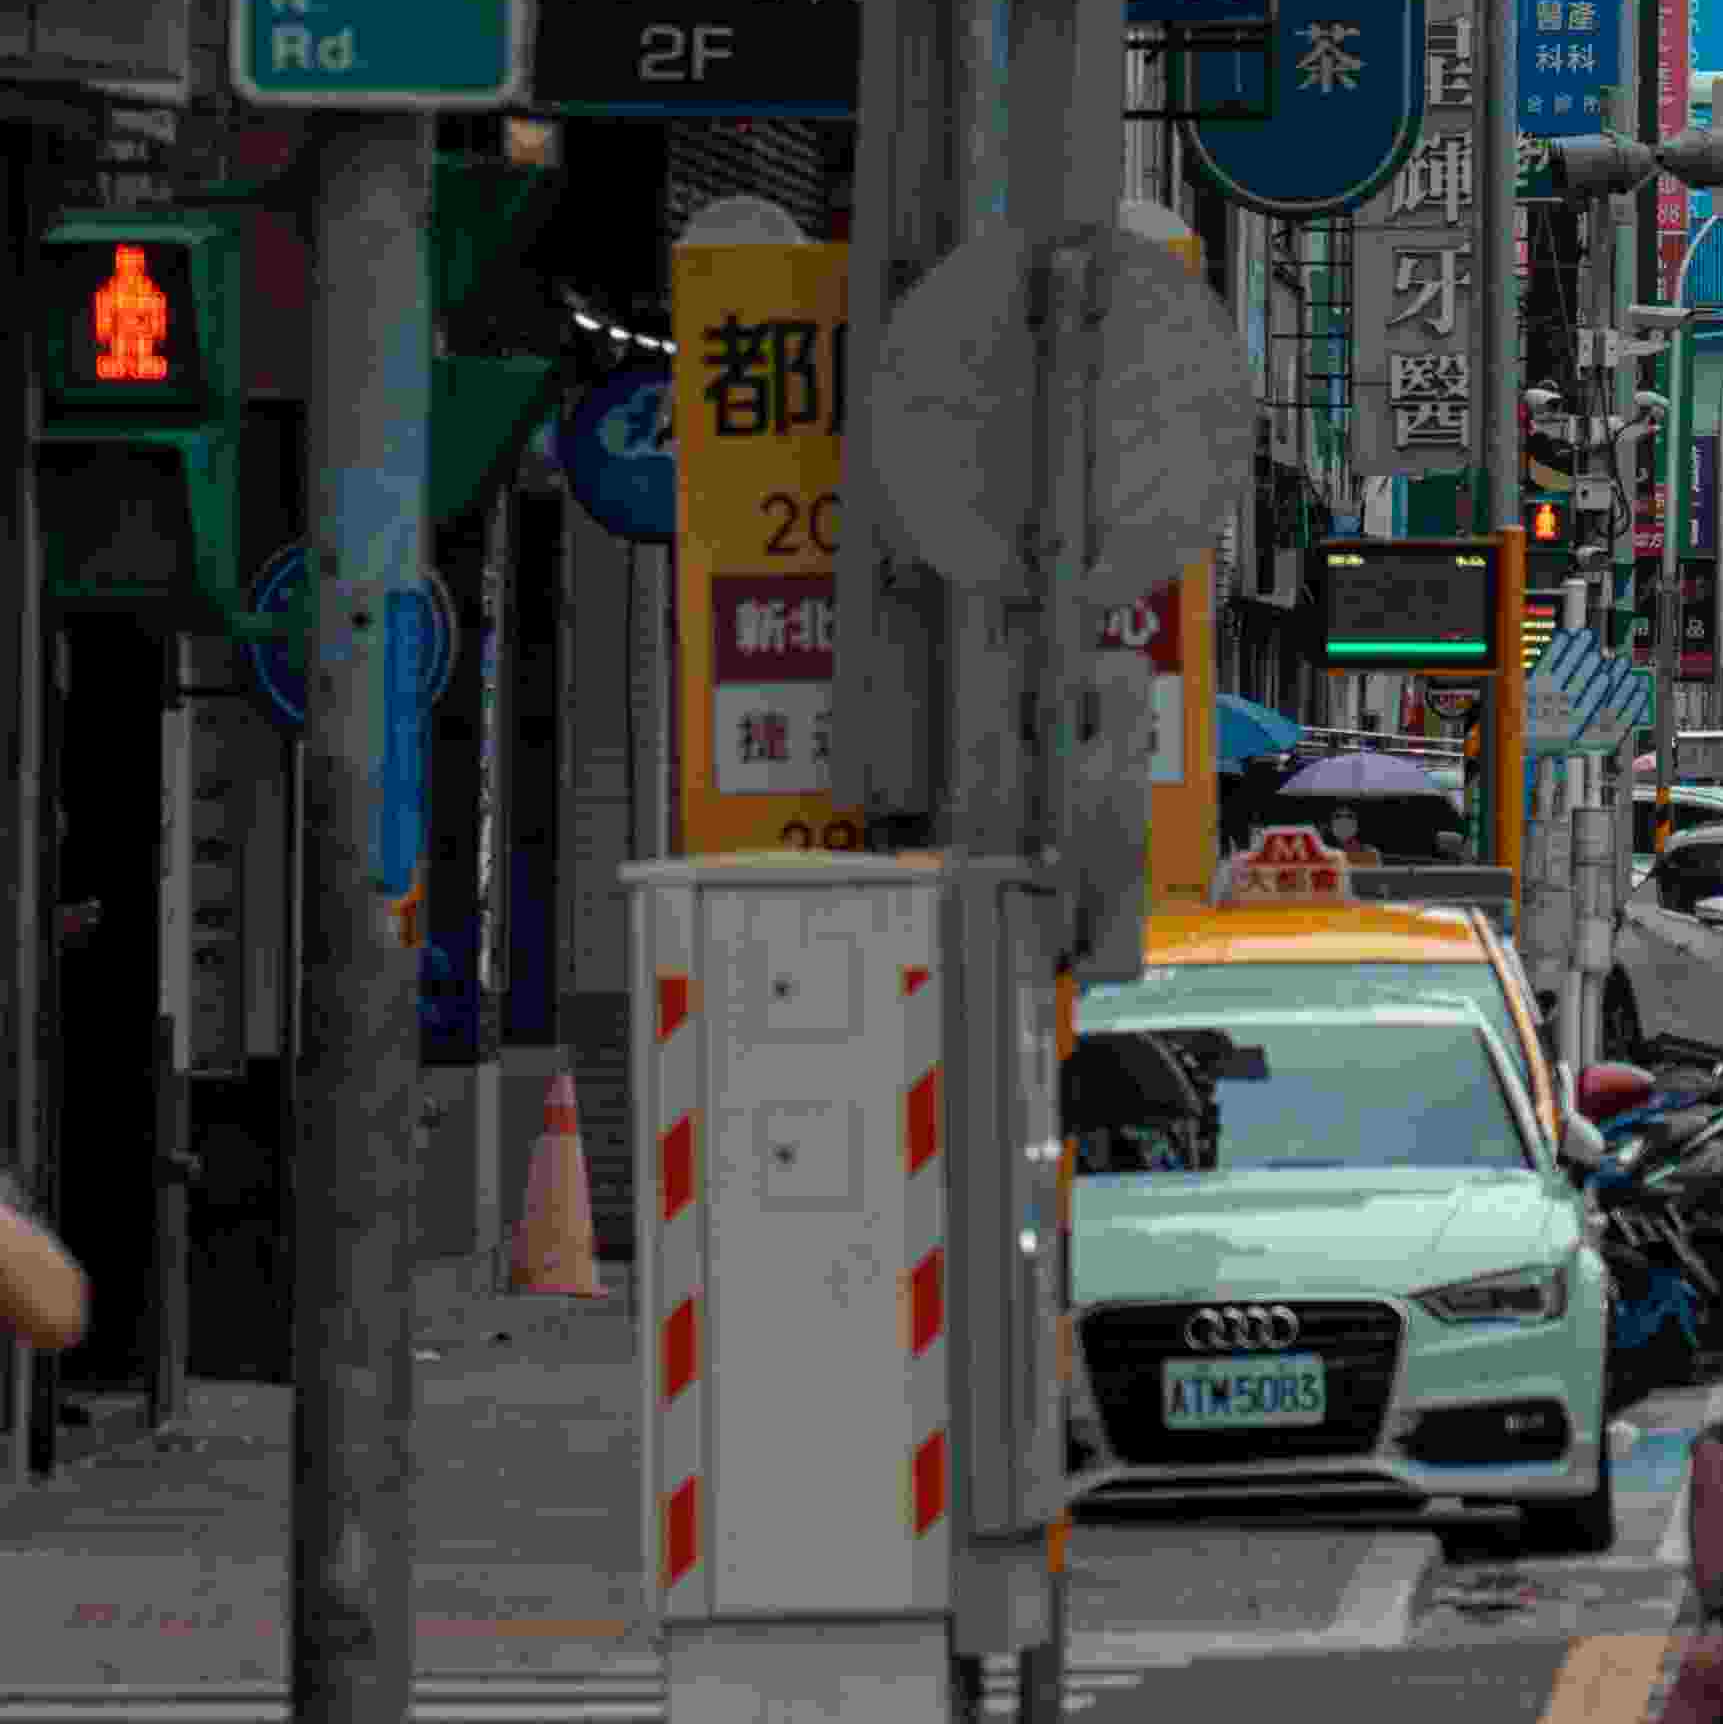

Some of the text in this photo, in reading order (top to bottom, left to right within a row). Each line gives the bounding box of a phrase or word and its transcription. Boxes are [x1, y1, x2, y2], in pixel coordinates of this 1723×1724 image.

[271, 26, 354, 70] Rd
[640, 26, 735, 81] 2F
[702, 314, 848, 437] 都
